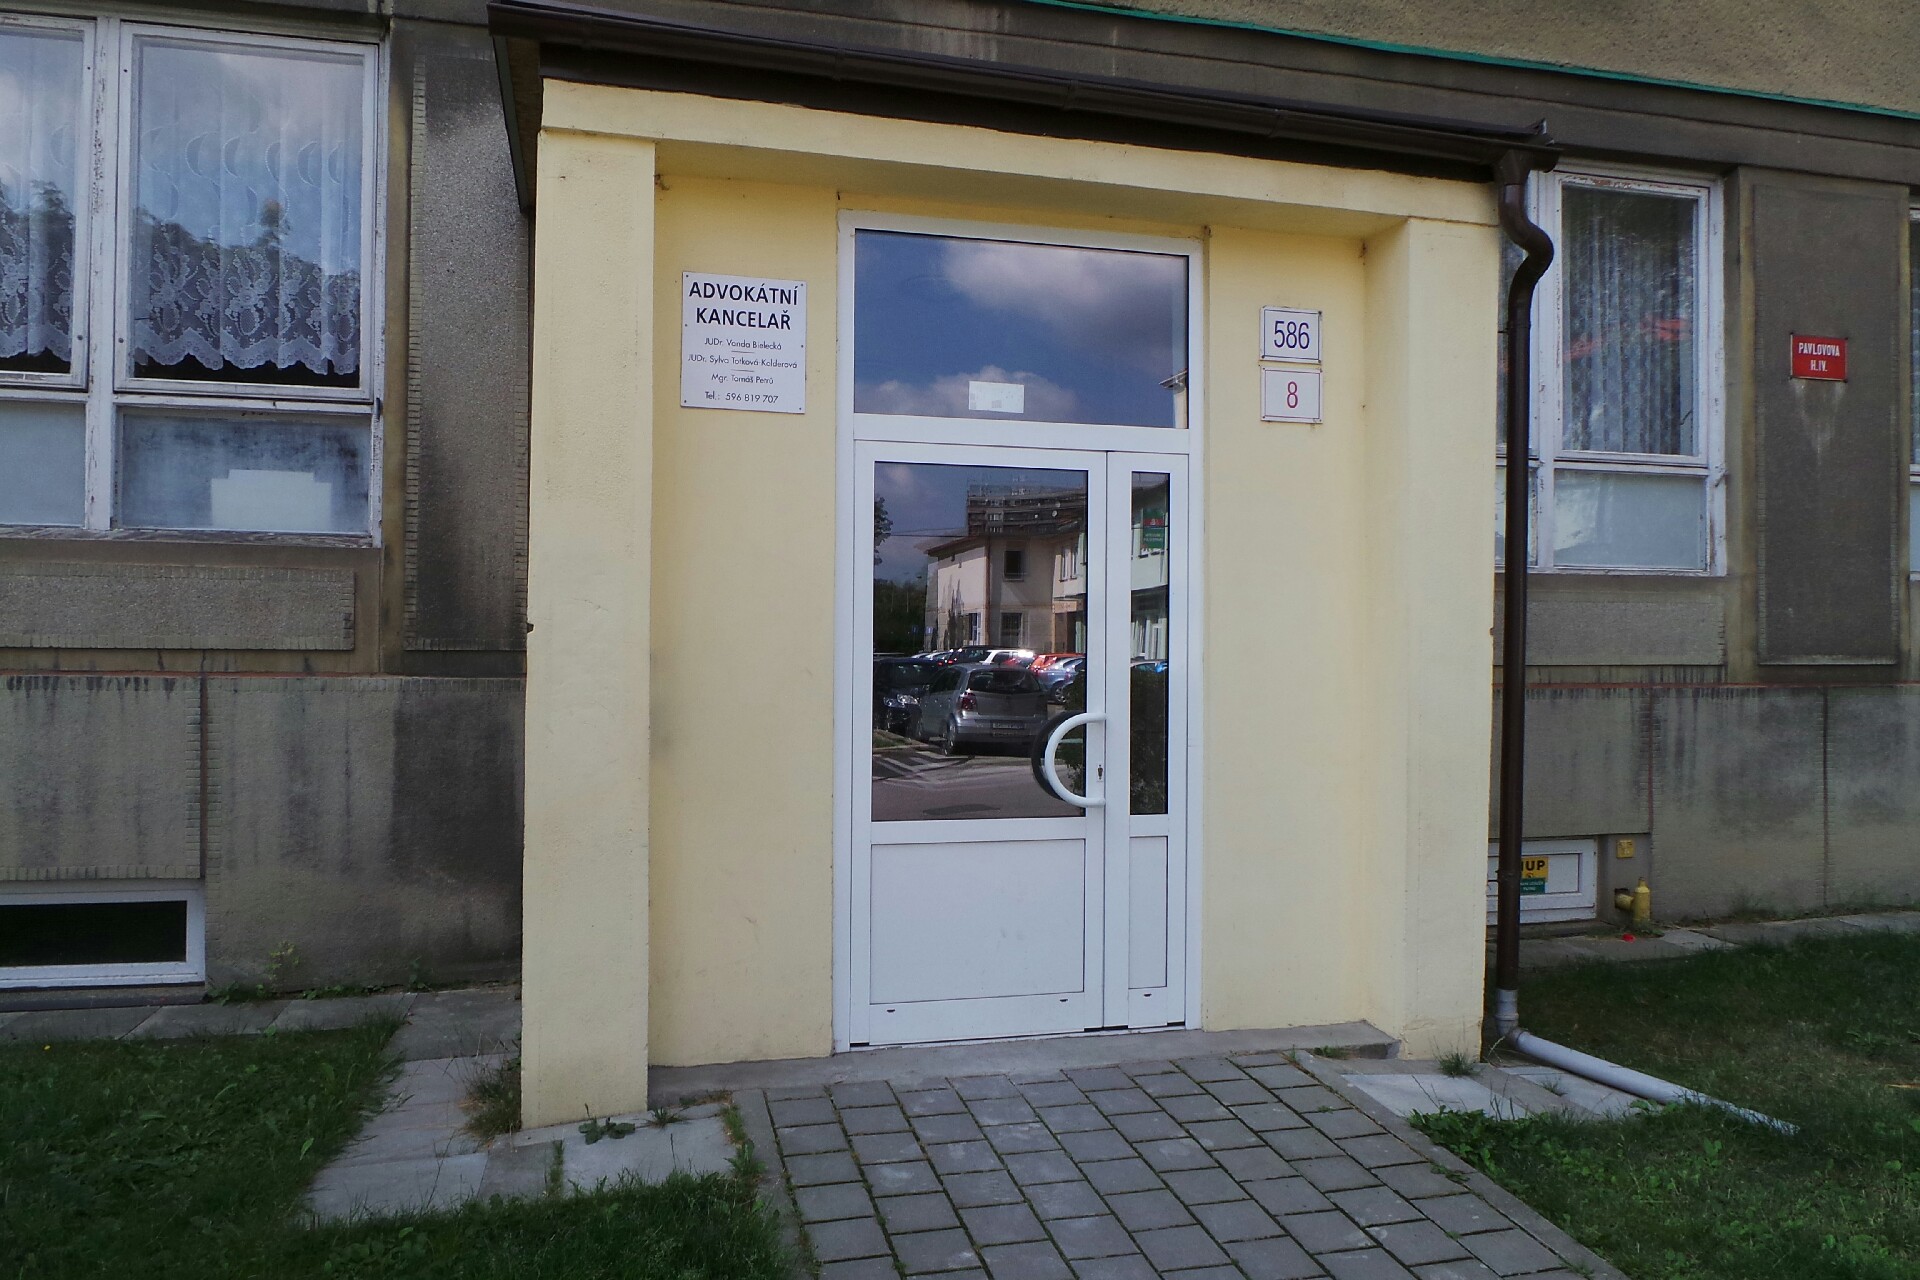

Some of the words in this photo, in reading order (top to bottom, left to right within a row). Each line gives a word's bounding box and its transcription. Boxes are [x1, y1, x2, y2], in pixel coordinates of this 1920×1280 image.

[689, 282, 799, 306] ADVOKÁTNÍ
[696, 307, 791, 330] KANCELAŘ
[1274, 320, 1310, 349] 586
[726, 339, 751, 348] Vanda
[1798, 342, 1840, 356] PAVLOVOVA
[688, 354, 707, 363] JUDr.
[709, 354, 729, 365] Sylva
[711, 373, 728, 384] Mgr.
[731, 374, 754, 384] Tomáš
[725, 392, 742, 401] 596
[744, 393, 761, 403] 819
[762, 395, 779, 404] 707
[1287, 381, 1298, 408] 8
